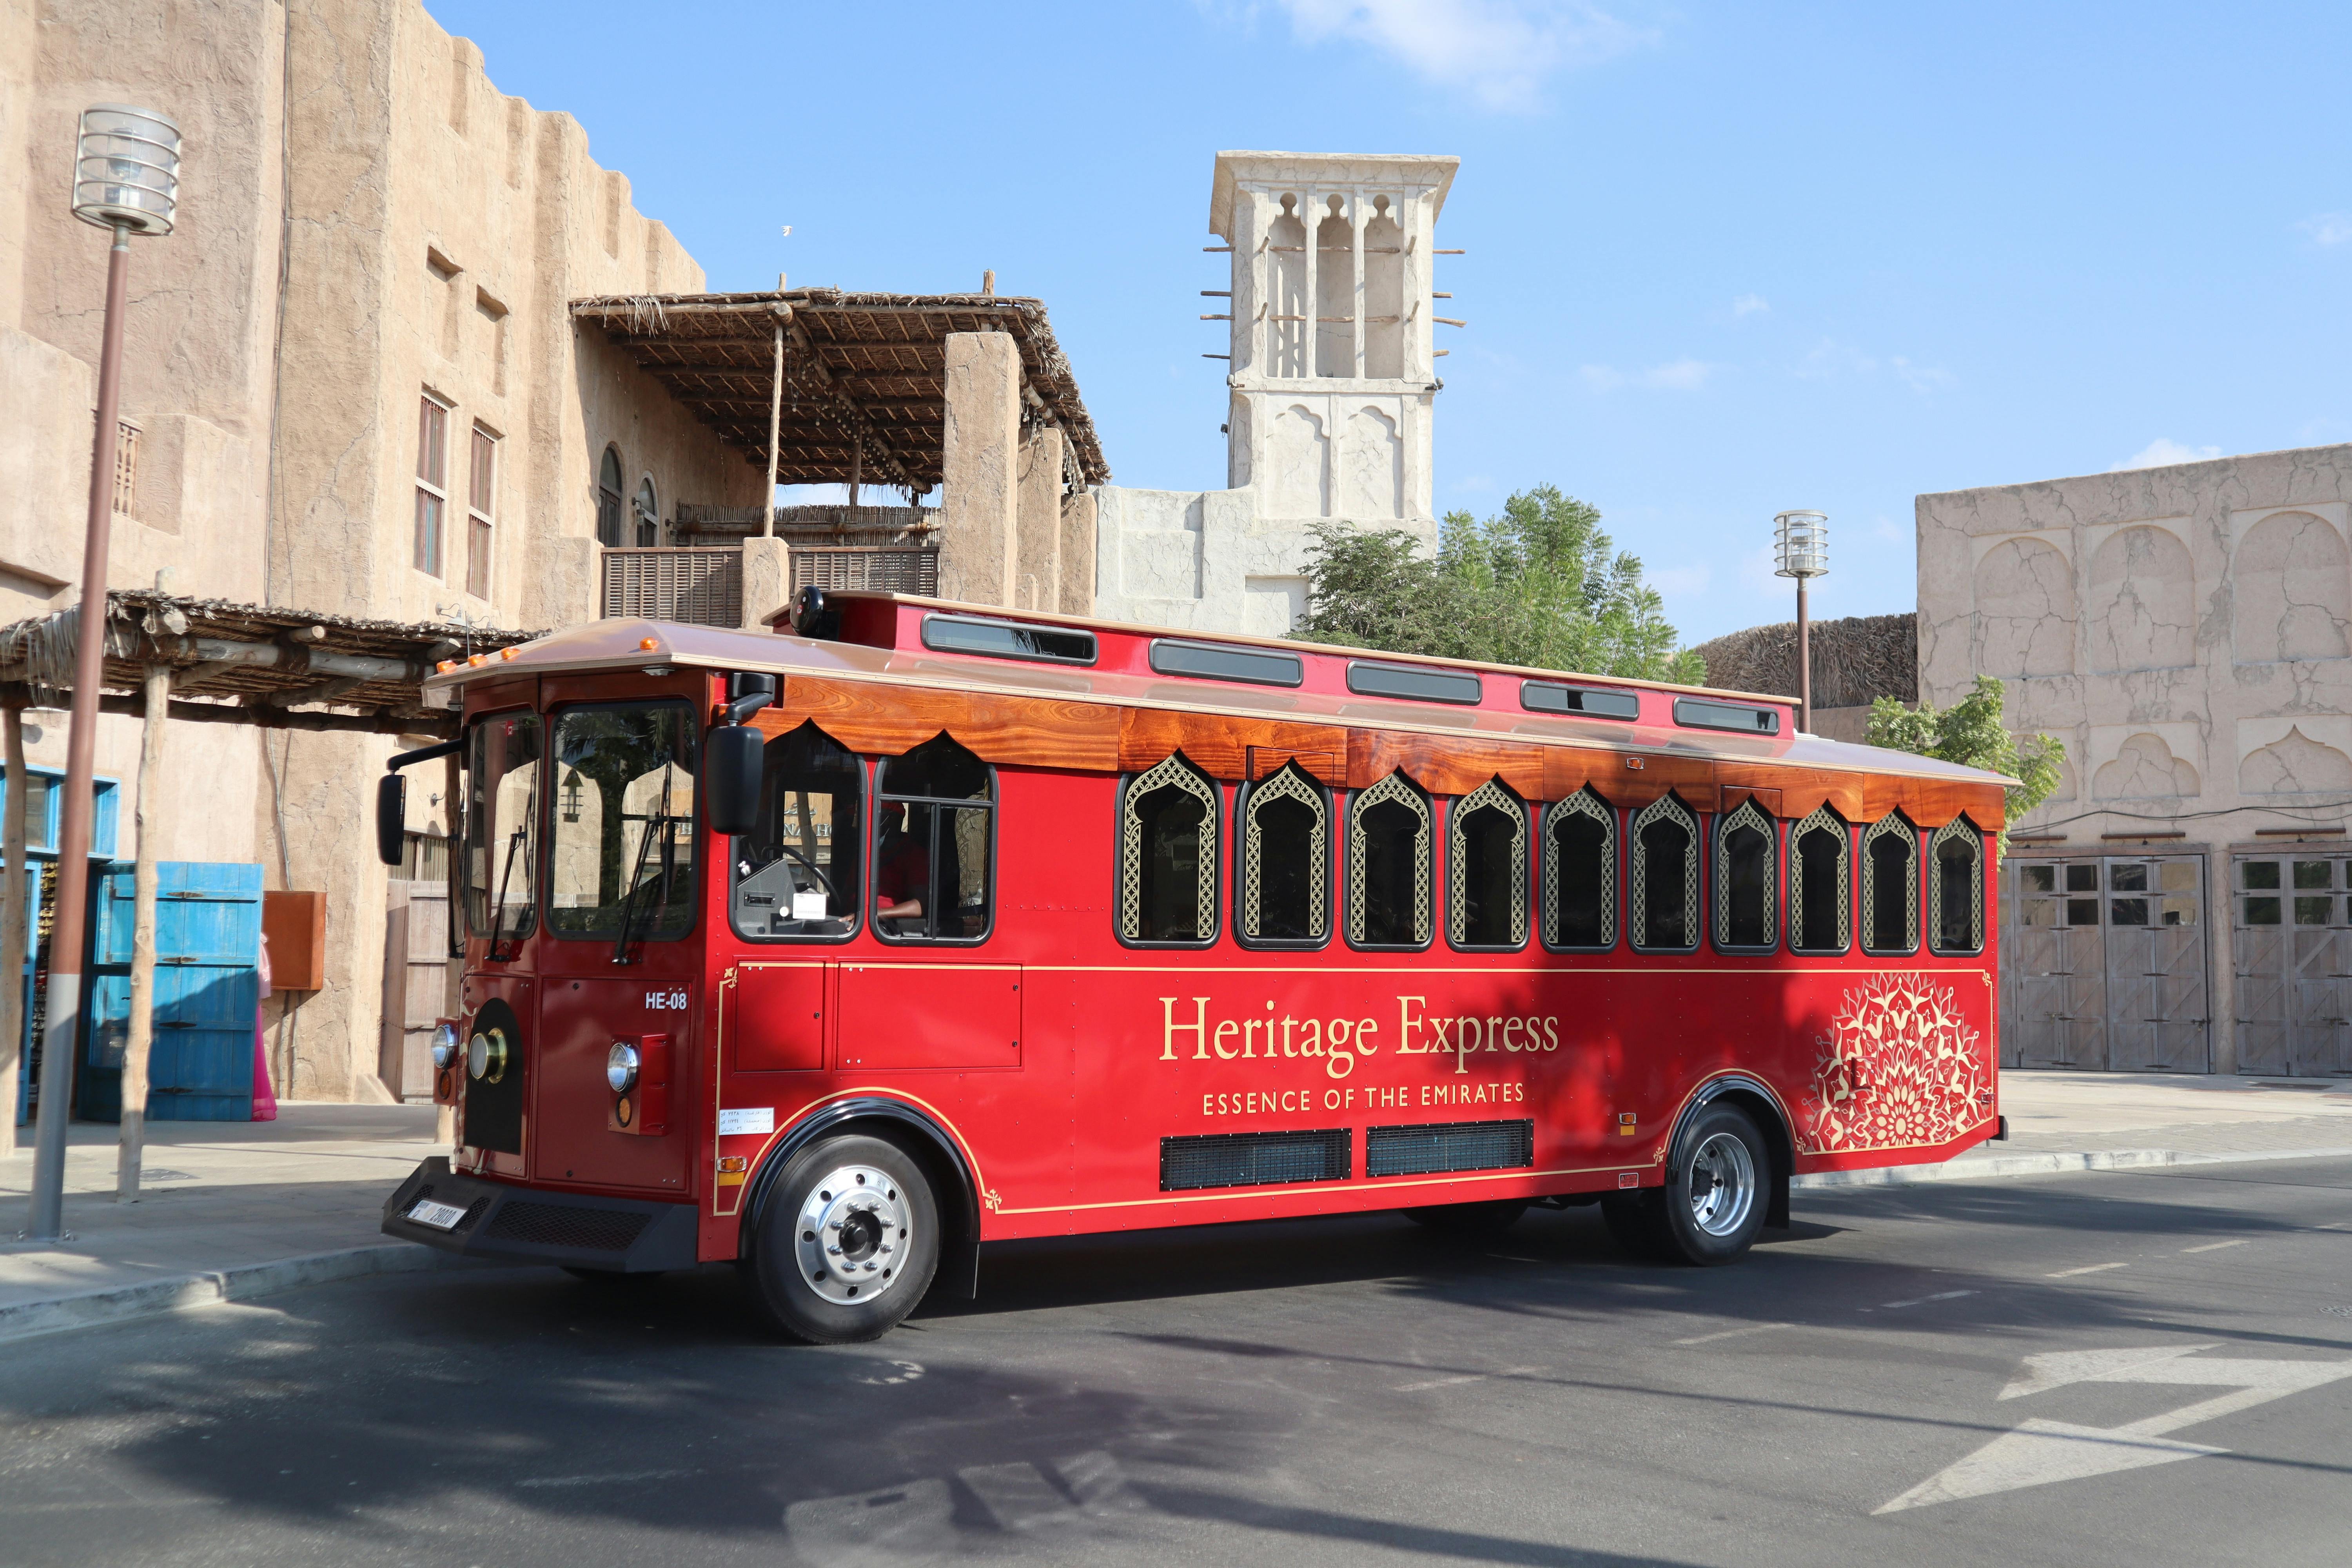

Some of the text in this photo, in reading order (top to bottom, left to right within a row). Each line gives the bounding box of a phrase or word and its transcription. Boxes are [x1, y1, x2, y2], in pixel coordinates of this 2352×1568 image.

[646, 992, 687, 1010] HE-08
[1159, 996, 1558, 1079] Heritage Express
[1203, 1083, 1523, 1115] ESSENCE OF THE EMIRATES
[429, 1207, 457, 1225] 29030
